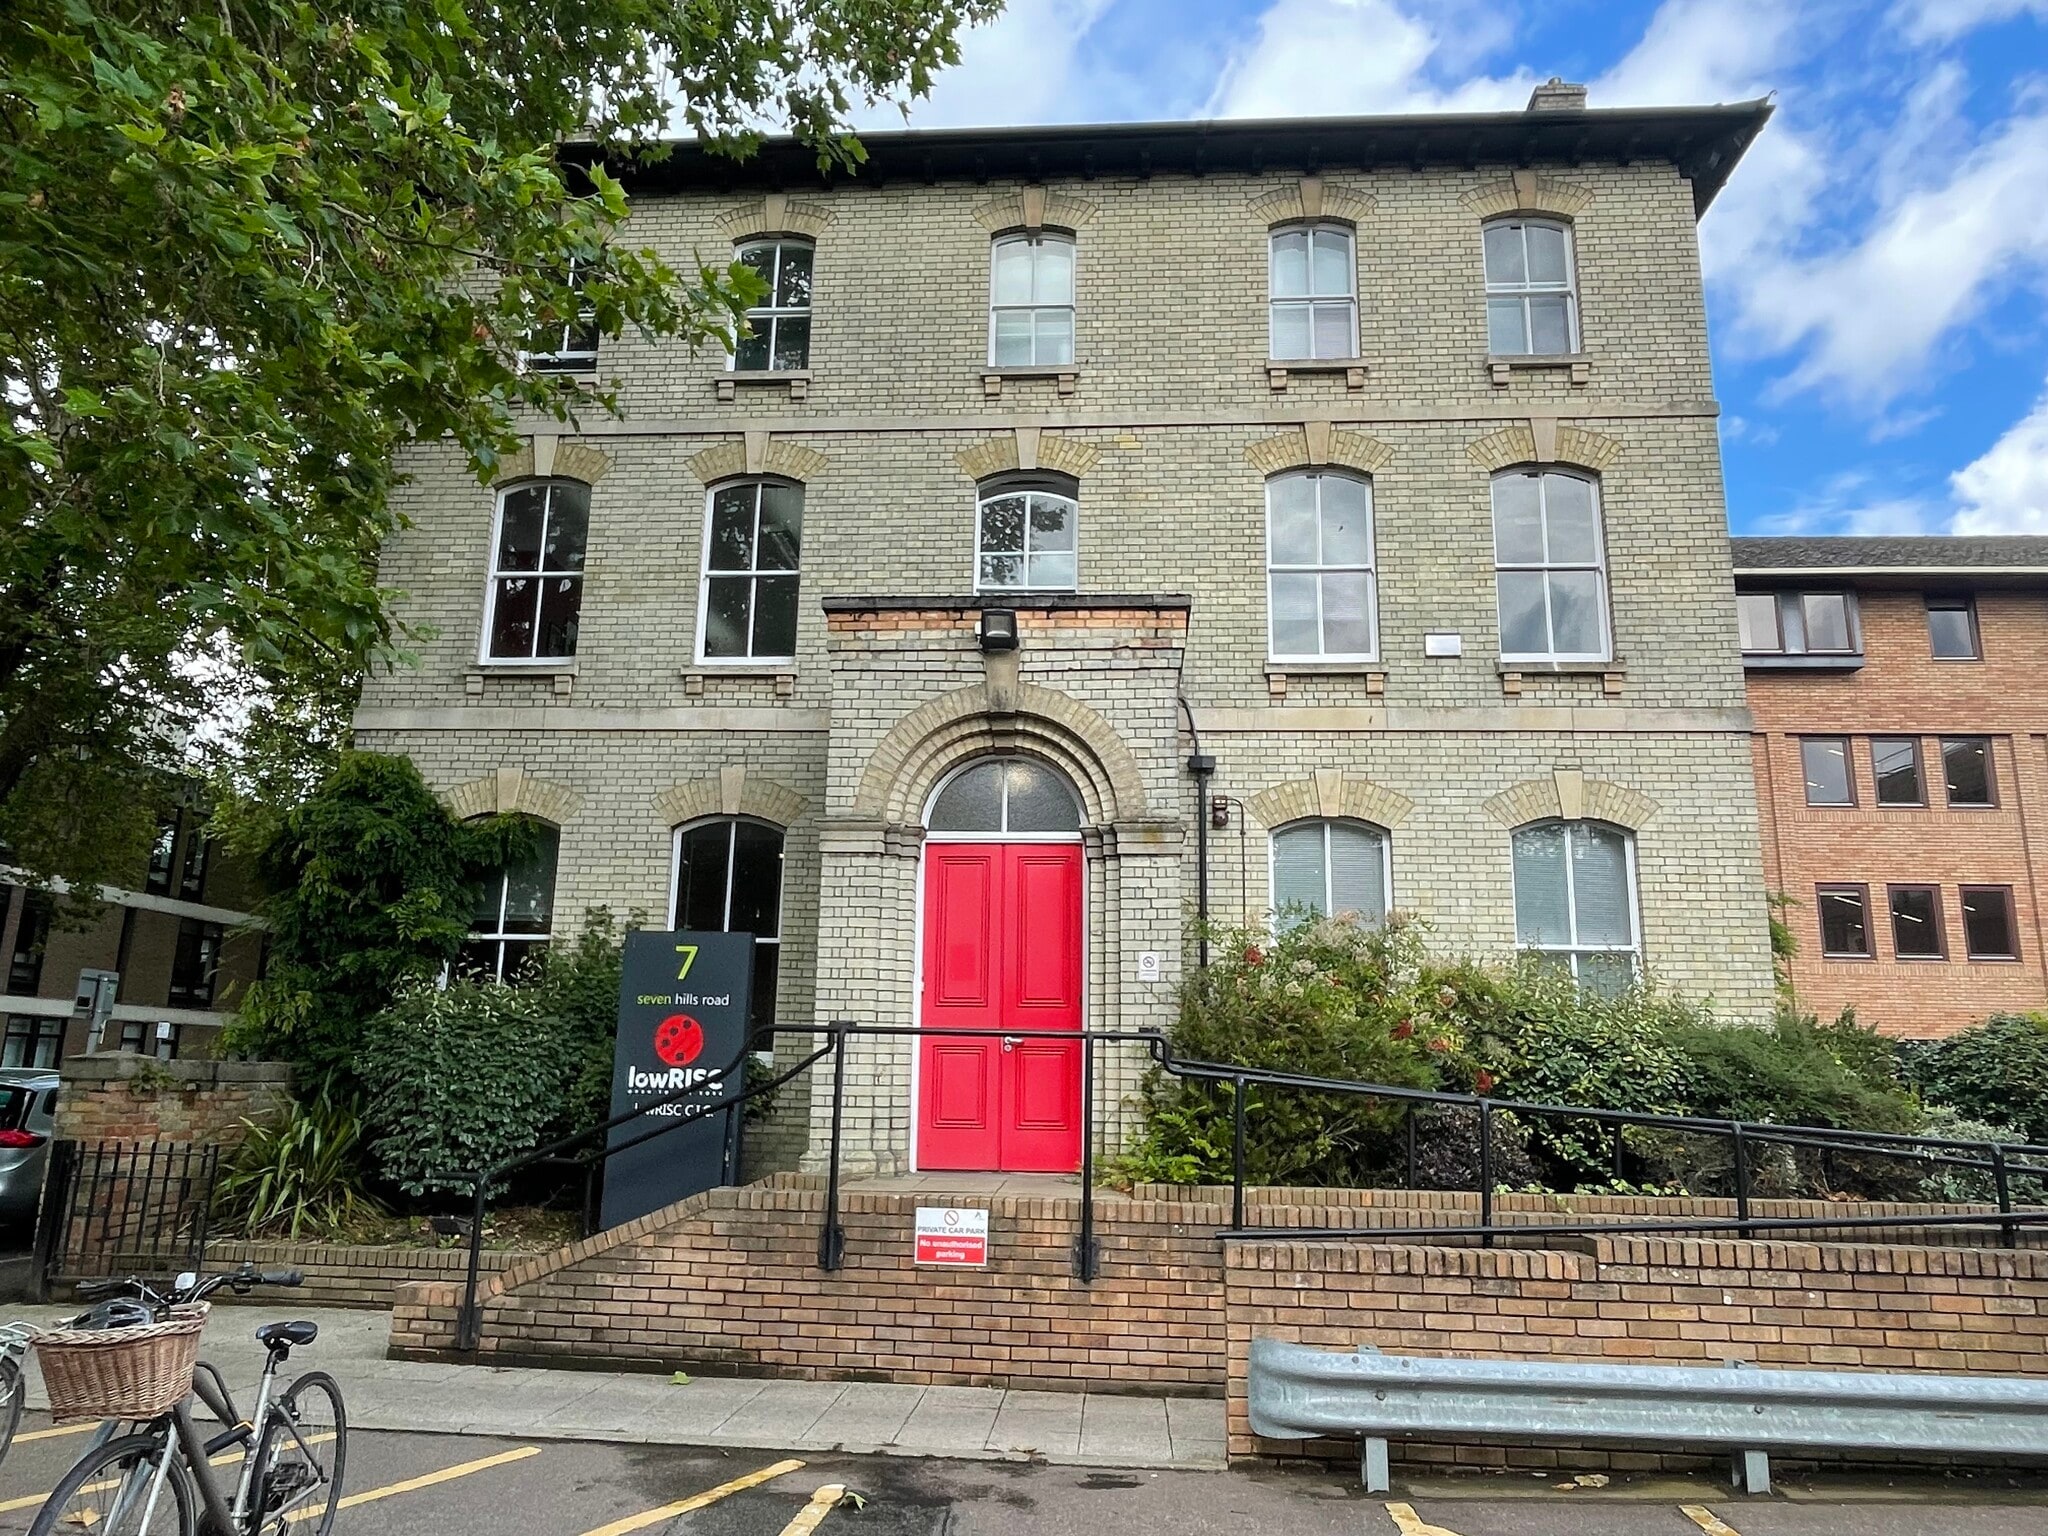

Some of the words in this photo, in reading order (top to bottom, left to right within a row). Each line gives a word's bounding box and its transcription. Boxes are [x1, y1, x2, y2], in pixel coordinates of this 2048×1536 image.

[676, 945, 699, 980] 7
[637, 995, 671, 1005] seven
[675, 993, 699, 1005] hills
[702, 993, 730, 1006] road
[628, 1065, 723, 1090] lowRISC
[935, 1250, 965, 1260] parking
